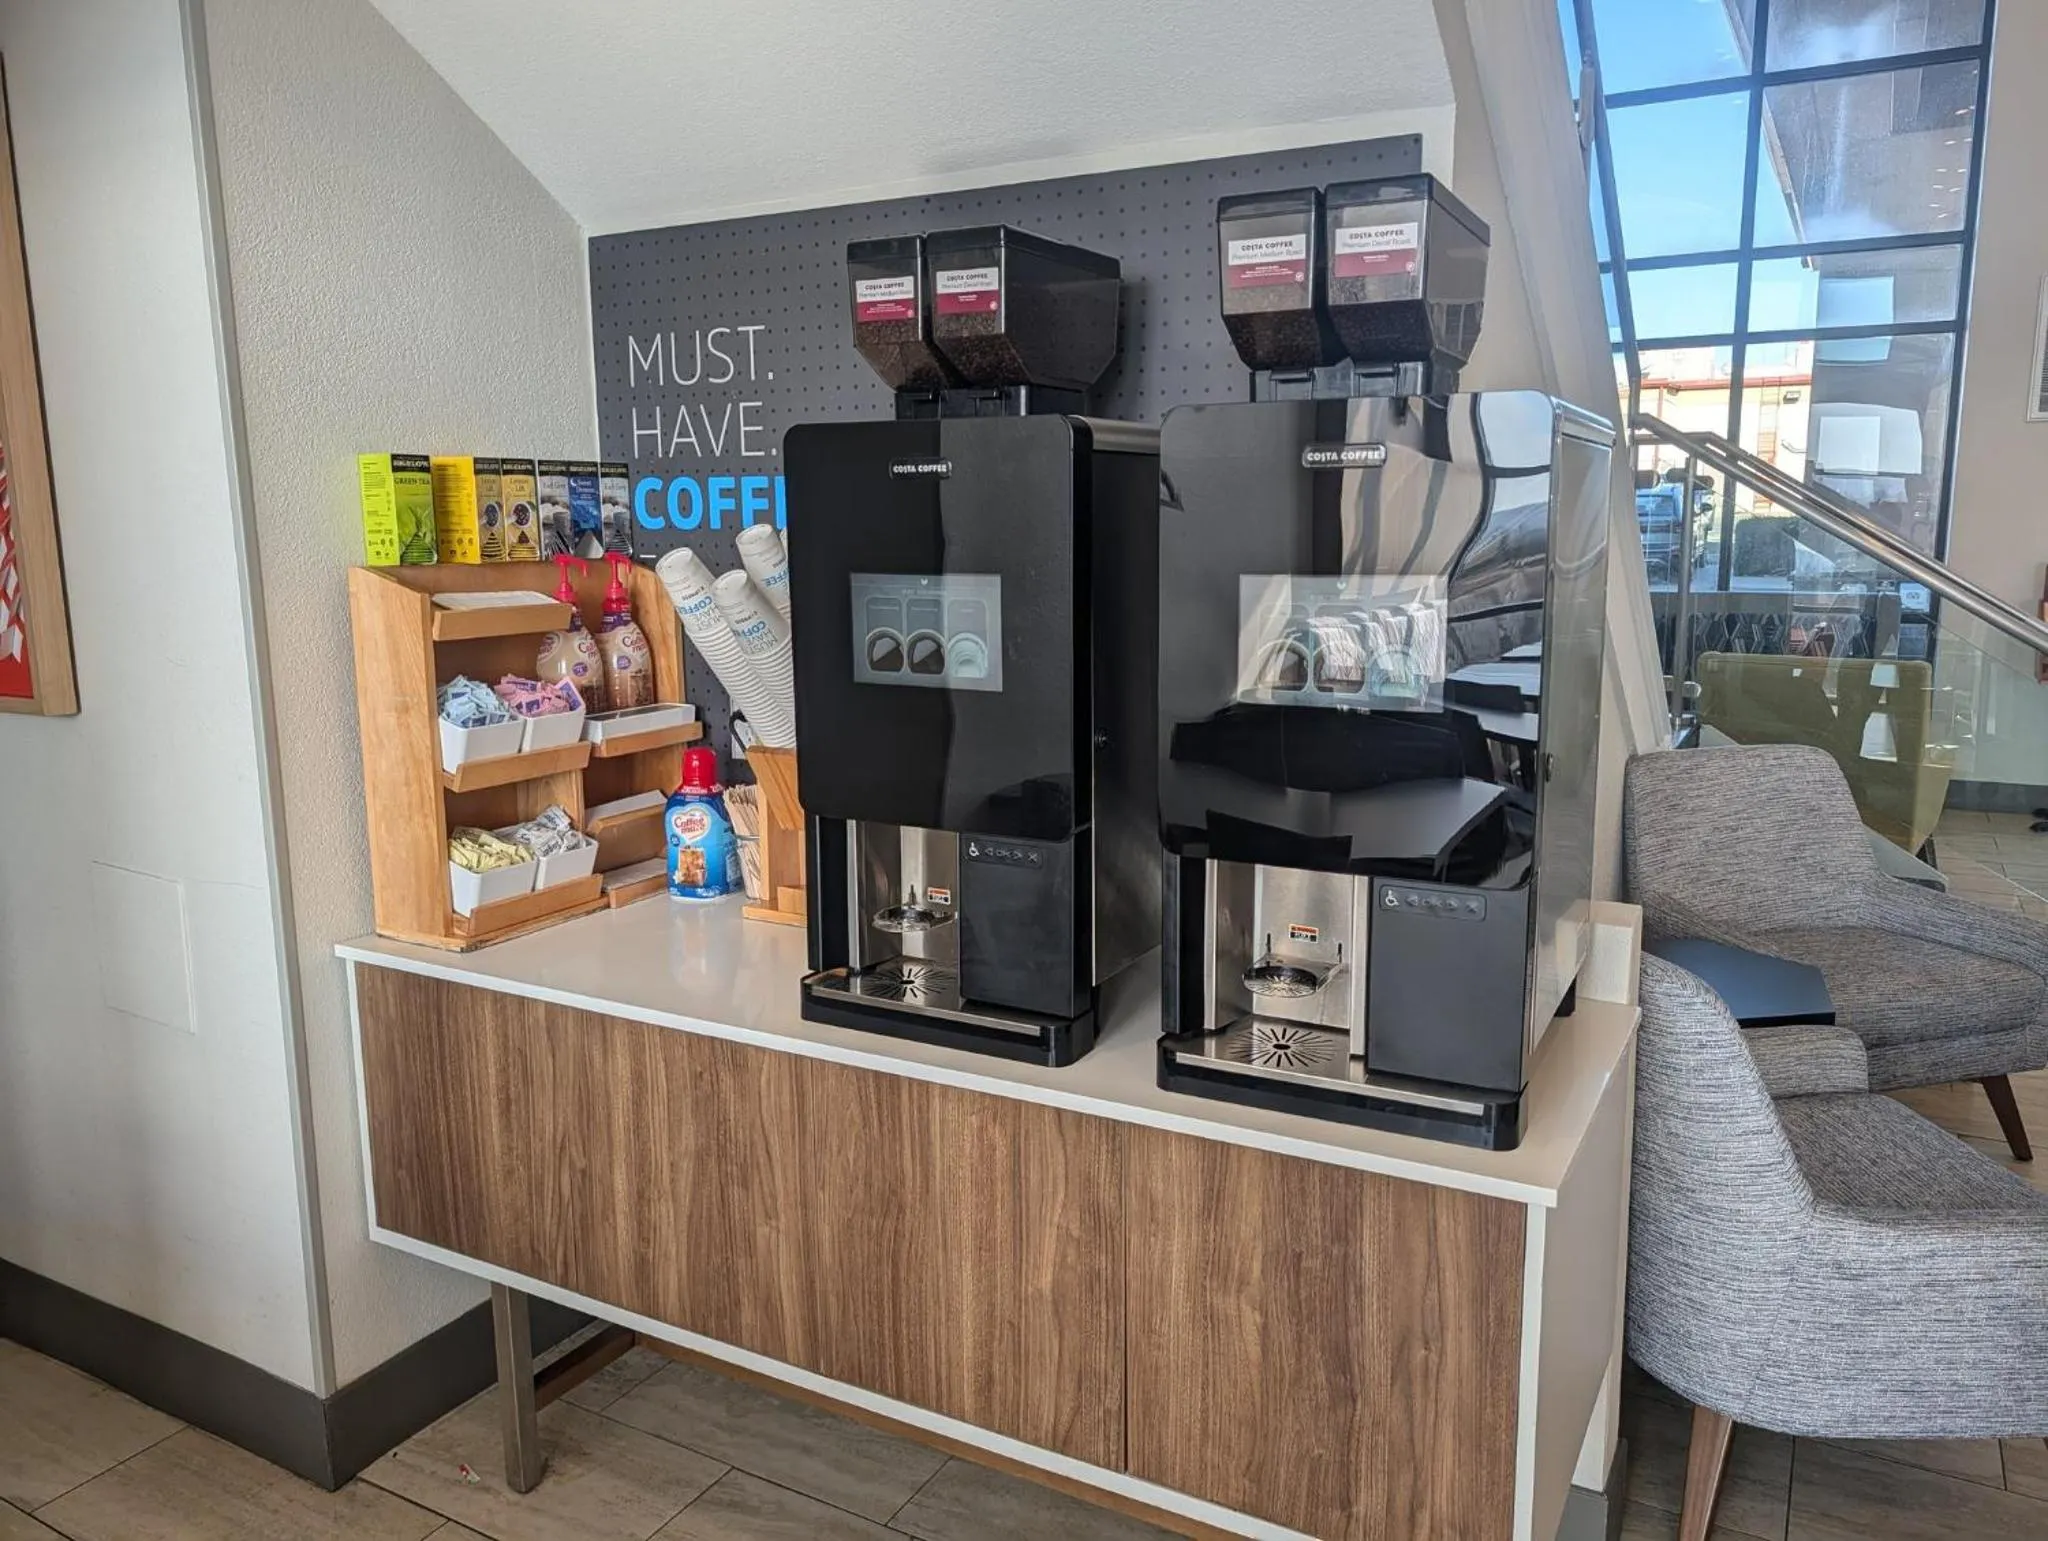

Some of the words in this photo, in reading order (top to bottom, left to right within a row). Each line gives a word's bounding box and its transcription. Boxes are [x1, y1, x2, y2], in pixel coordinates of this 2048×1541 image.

[1349, 232, 1372, 240] COSTA
[1374, 229, 1404, 238] COFFEE
[1241, 243, 1264, 251] COSTA
[1265, 240, 1293, 249] COFFEE
[966, 272, 988, 280] COFFEE
[628, 325, 774, 388] MUST.
[632, 401, 777, 460] HAVE.
[1306, 450, 1338, 461] COSTA
[1340, 448, 1380, 460] COFFEE
[893, 464, 916, 473] COSTA
[918, 464, 947, 473] COFFEE
